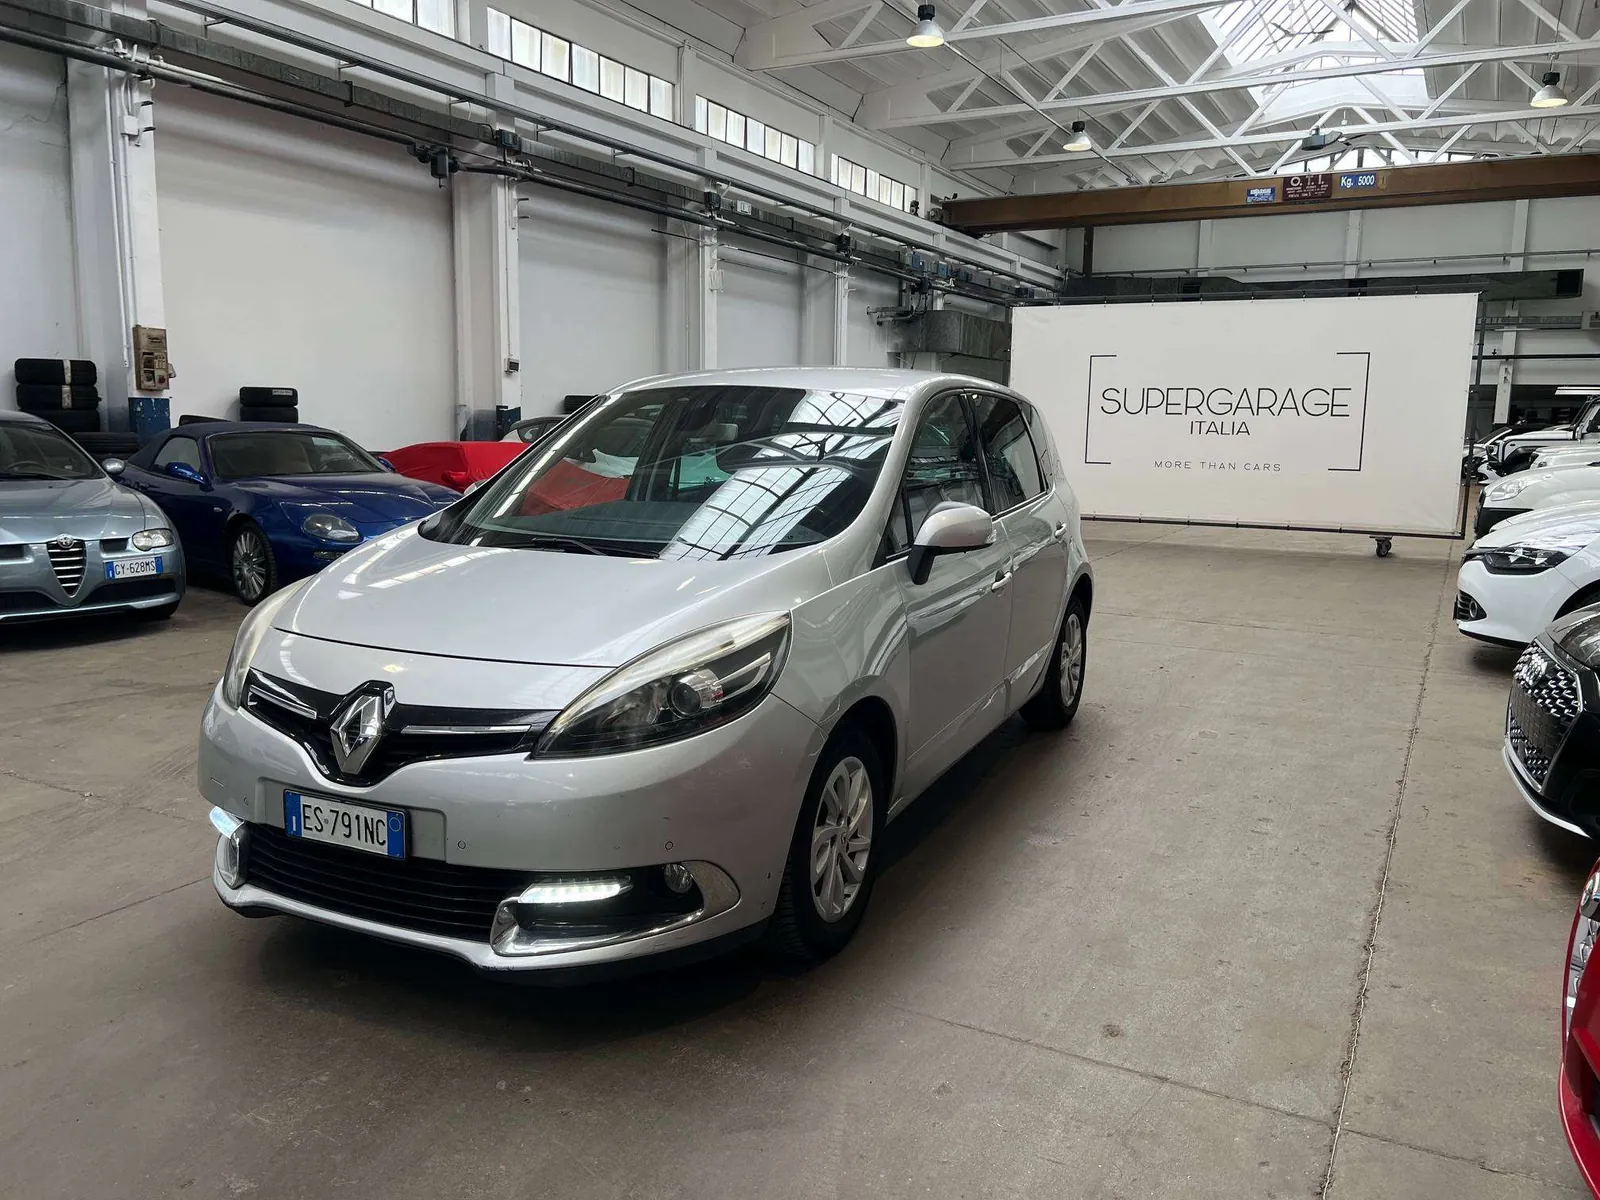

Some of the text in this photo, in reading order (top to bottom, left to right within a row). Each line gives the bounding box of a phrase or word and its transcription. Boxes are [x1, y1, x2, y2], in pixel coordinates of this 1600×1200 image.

[1341, 176, 1354, 188] Kg.
[1357, 174, 1375, 186] 5000
[1100, 387, 1352, 417] SUPERGARAGE
[1190, 420, 1251, 436] ITALIA
[1154, 460, 1282, 472] MORE THAN CARS
